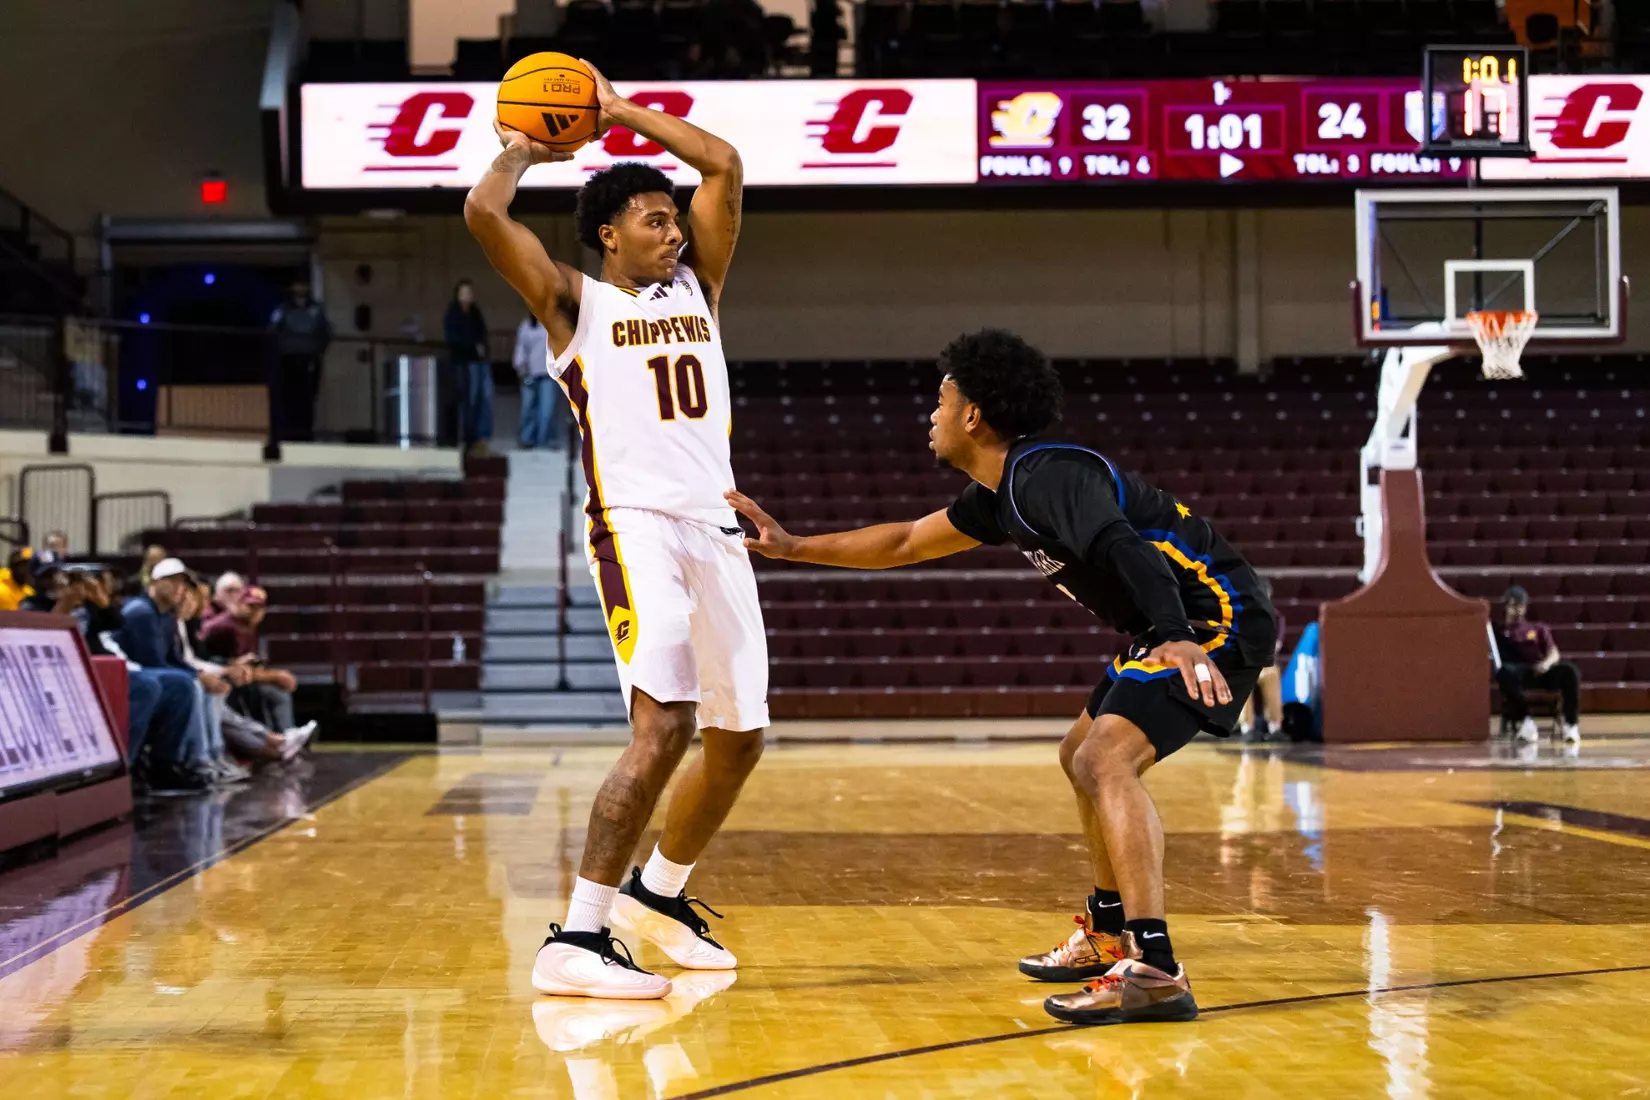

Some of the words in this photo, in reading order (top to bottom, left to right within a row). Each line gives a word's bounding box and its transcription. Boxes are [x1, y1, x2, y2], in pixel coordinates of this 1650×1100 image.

[1463, 56, 1516, 85] 1:01
[551, 84, 581, 95] PRO
[1082, 104, 1131, 141] 32
[1318, 102, 1367, 139] 24
[1464, 87, 1508, 136] 17
[1184, 113, 1262, 150] 1:01
[646, 354, 709, 421] 10
